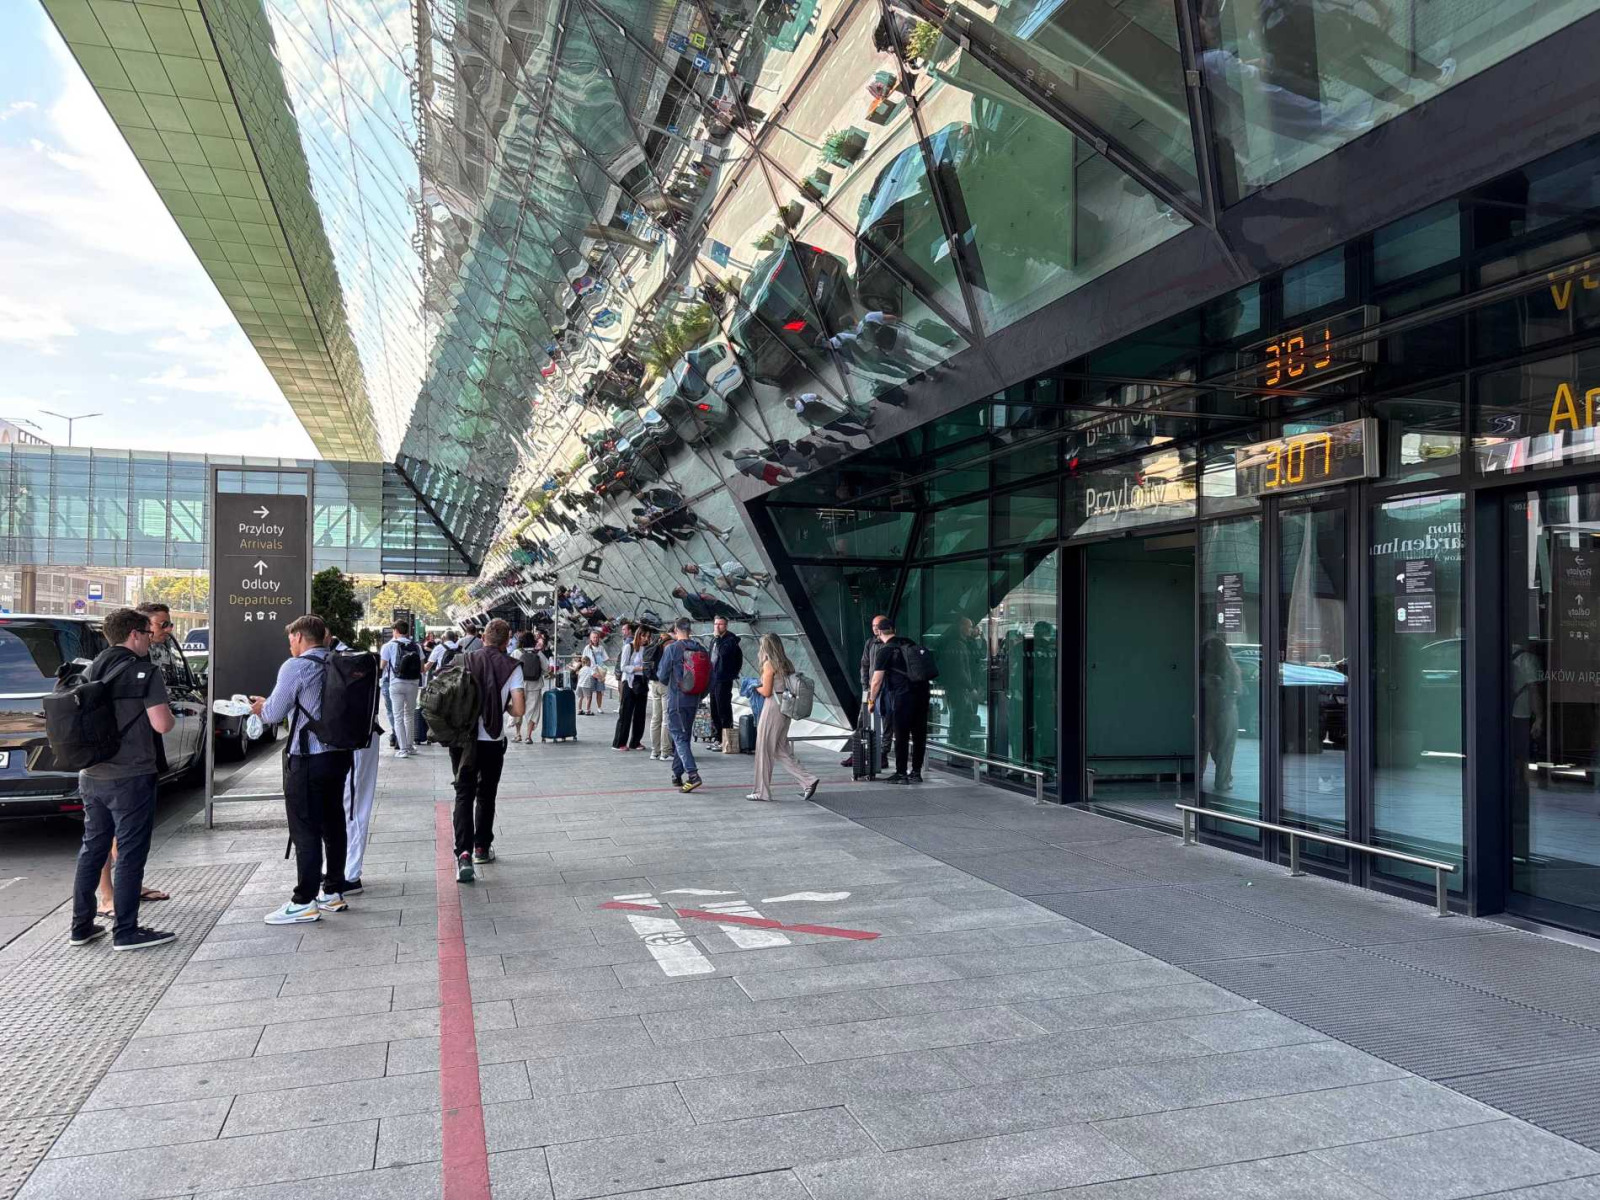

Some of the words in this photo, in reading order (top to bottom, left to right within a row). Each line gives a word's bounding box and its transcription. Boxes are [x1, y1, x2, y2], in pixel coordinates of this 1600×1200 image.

[1086, 477, 1165, 521] Przyloty
[238, 523, 285, 537] Przyloty
[240, 538, 283, 550] Arrivals
[241, 579, 281, 592] Odloty
[229, 594, 293, 607] Departures
